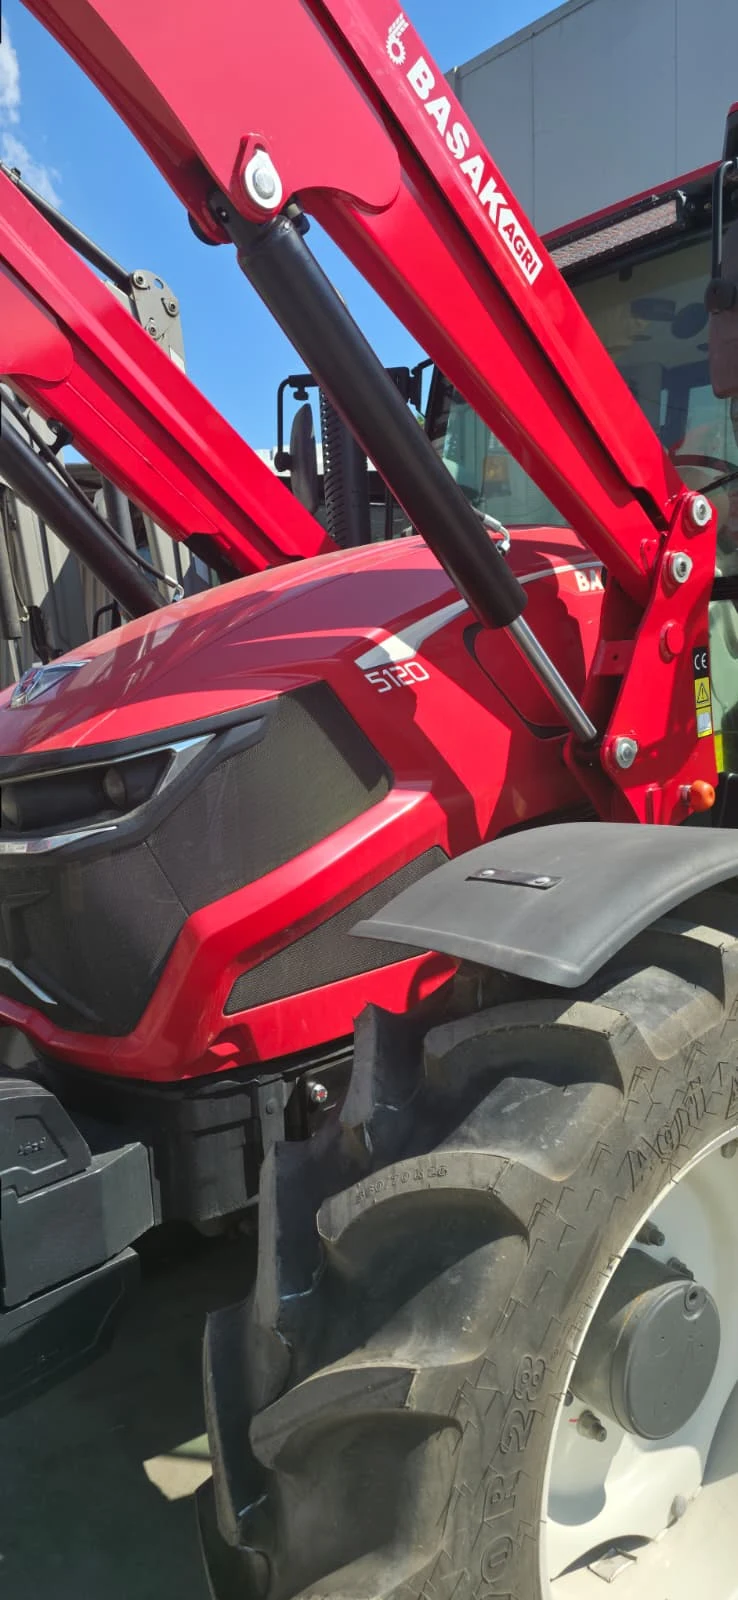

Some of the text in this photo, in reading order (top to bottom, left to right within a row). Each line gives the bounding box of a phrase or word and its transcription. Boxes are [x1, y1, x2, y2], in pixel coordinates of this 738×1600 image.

[503, 222, 538, 277] AGRI
[364, 661, 431, 694] 5120
[694, 652, 708, 670] CE
